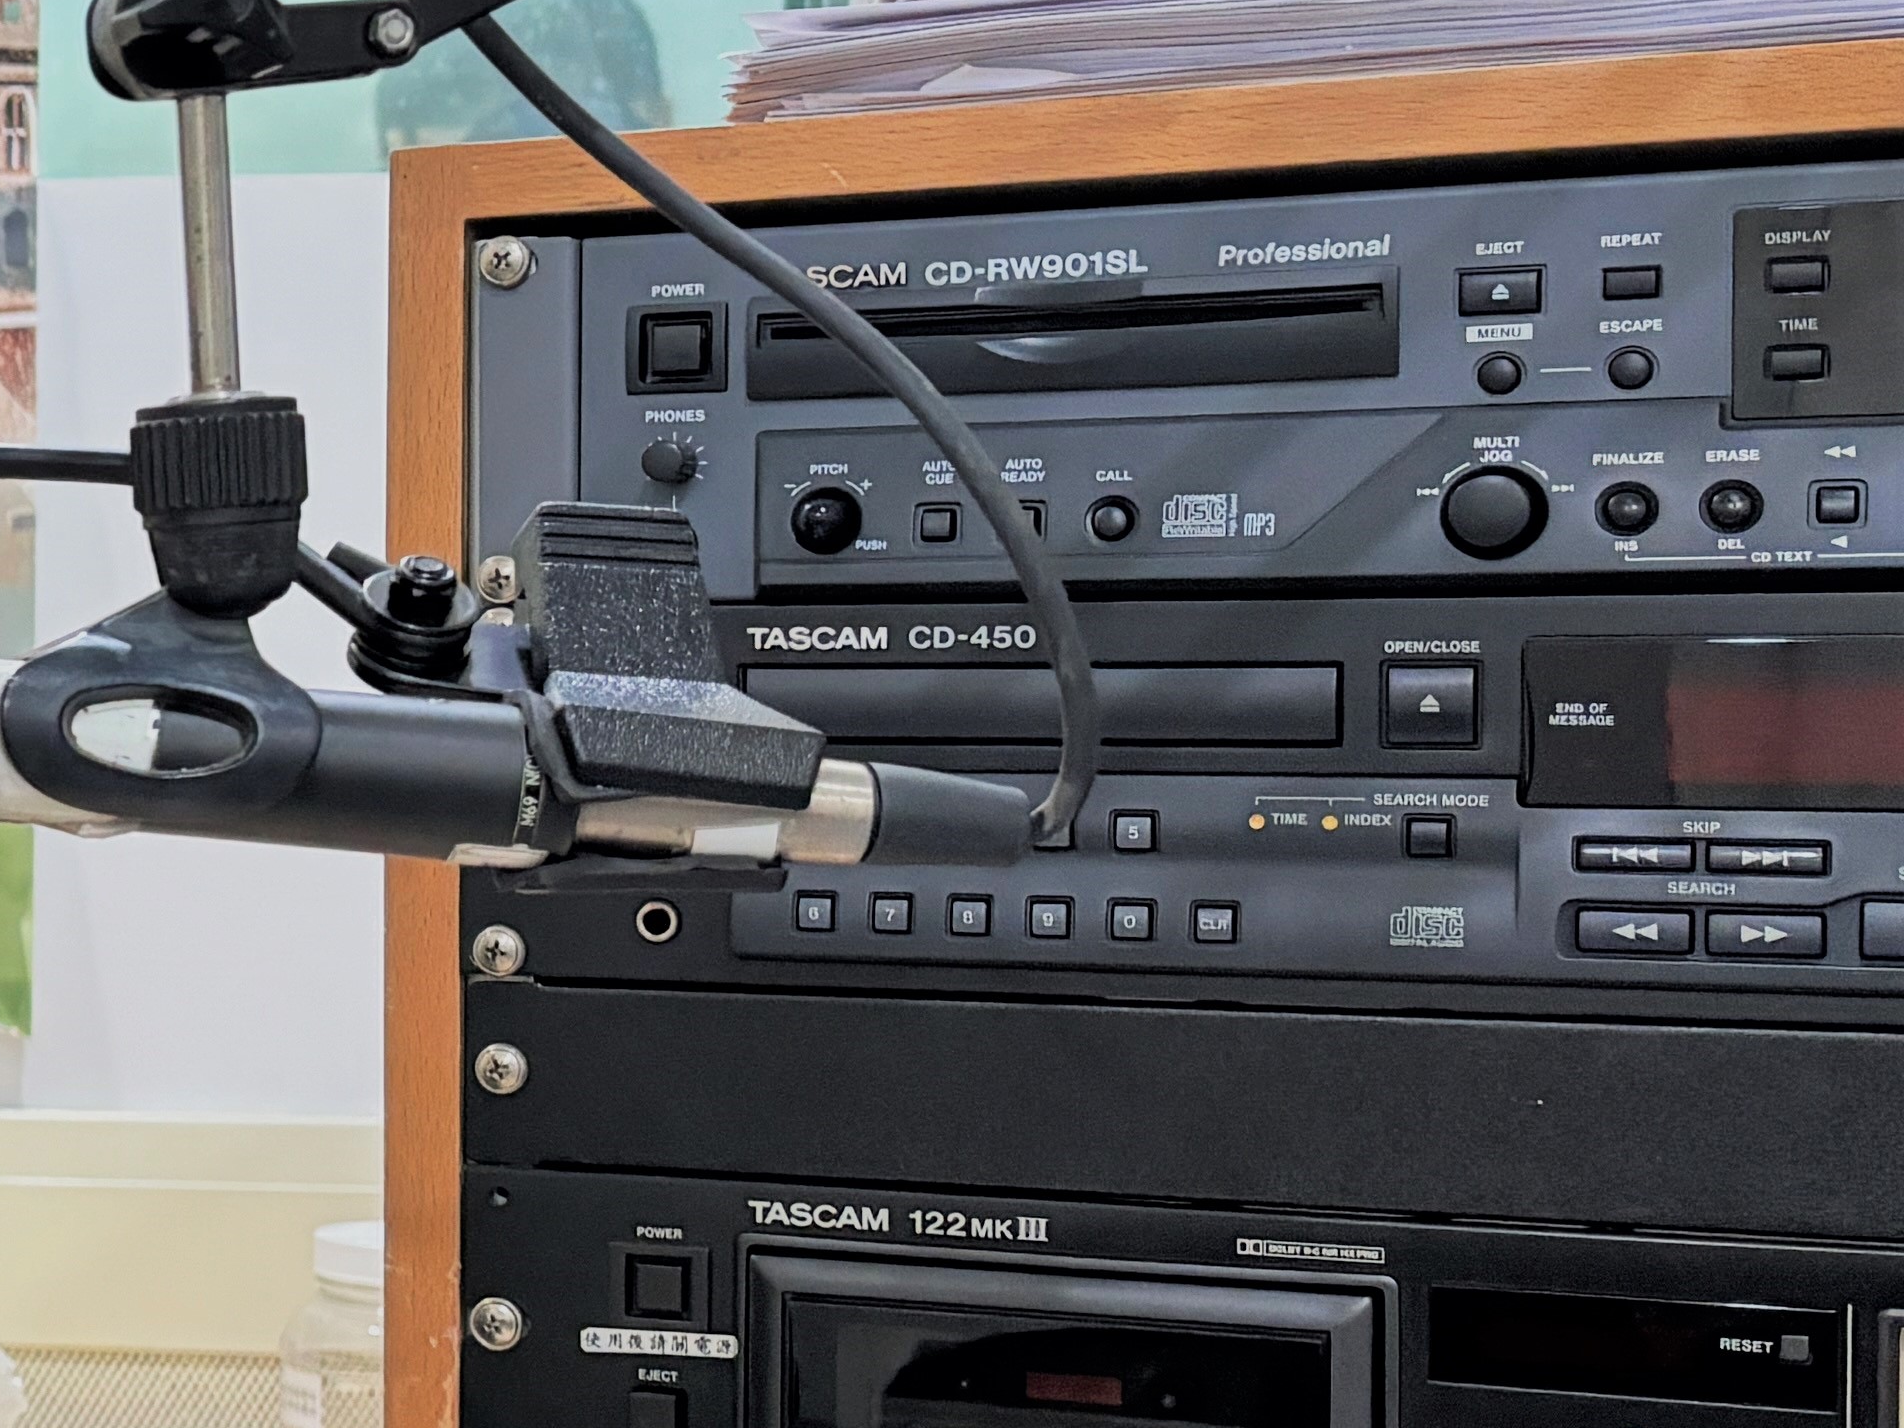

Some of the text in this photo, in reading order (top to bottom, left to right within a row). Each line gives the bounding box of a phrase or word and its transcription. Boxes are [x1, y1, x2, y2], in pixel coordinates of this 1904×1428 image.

[1600, 232, 1663, 248] REPEAT
[1763, 229, 1832, 247] DISPLAY
[1475, 240, 1525, 256] EJECT
[806, 233, 1391, 289] SCAM CD-RW901SL Professional
[650, 283, 705, 299] POWER
[1476, 325, 1524, 341] MENU
[1598, 317, 1664, 334] ESCAPE
[1779, 317, 1819, 333] TIME
[643, 407, 706, 425] PHONES
[1473, 434, 1521, 451] MULTI
[1478, 448, 1514, 464] JOG
[1592, 450, 1665, 466] FINALIZE
[1704, 447, 1761, 463] ERASE
[809, 461, 849, 476] PITCH
[1004, 457, 1044, 472] AUTO
[924, 471, 955, 486] CUE
[1094, 468, 1133, 483] CALL
[1243, 512, 1276, 537] MP3
[854, 538, 888, 553] PUSH
[1717, 537, 1745, 551] DEL
[1749, 549, 1814, 564] CD TEXT
[746, 623, 1037, 652] TASCAM CD-450
[1383, 639, 1481, 655] OPEN/CLOSE
[1553, 701, 1609, 715] END OF
[1547, 714, 1616, 728] MESSAGE
[1372, 792, 1490, 808] SEARCH MODE
[1270, 812, 1392, 828] TIME INDEX
[1681, 819, 1722, 835] SKIP
[1127, 824, 1140, 841] 5
[1666, 880, 1737, 897] SEARCH
[807, 905, 1137, 930] 6 7 8 9 0
[747, 1198, 891, 1233] TASCAM
[635, 1225, 684, 1241] POWER
[1719, 1336, 1774, 1355] RESET
[637, 1368, 680, 1384] EJECT
